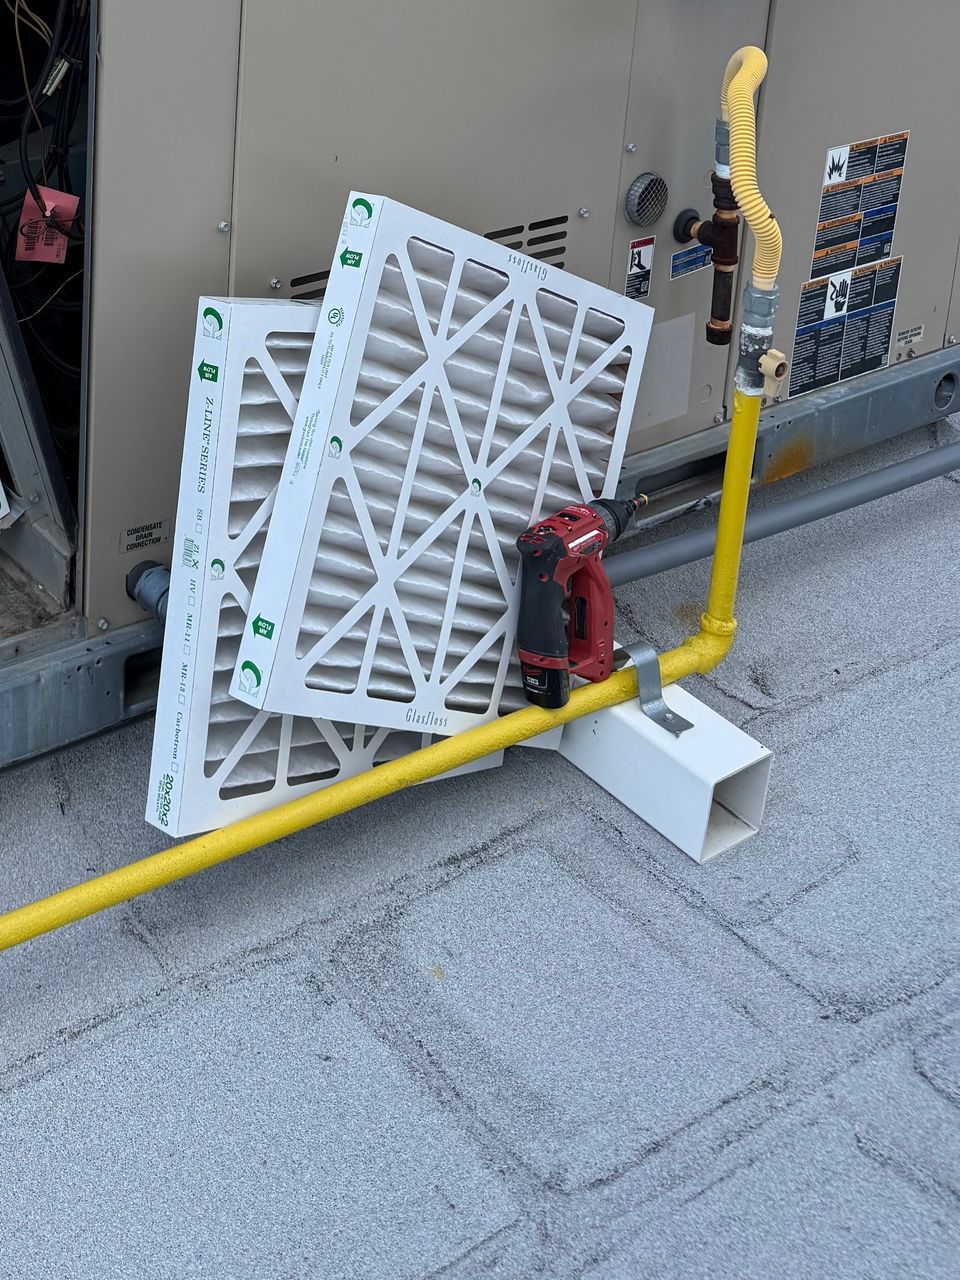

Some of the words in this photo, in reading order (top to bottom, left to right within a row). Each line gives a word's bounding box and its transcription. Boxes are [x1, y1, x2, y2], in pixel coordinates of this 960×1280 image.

[508, 254, 548, 281] Glasfloss
[197, 445, 210, 494] SERIES
[126, 521, 163, 537] CONDENSATE
[135, 531, 153, 542] DRAIN
[126, 536, 162, 551] CONNECTION
[189, 578, 196, 594] HV
[184, 612, 193, 643] MR-11
[179, 662, 189, 693] MR-13
[405, 707, 448, 727] Glasfloss
[172, 711, 183, 760] Carbotron
[161, 773, 174, 827] 20x20x2
